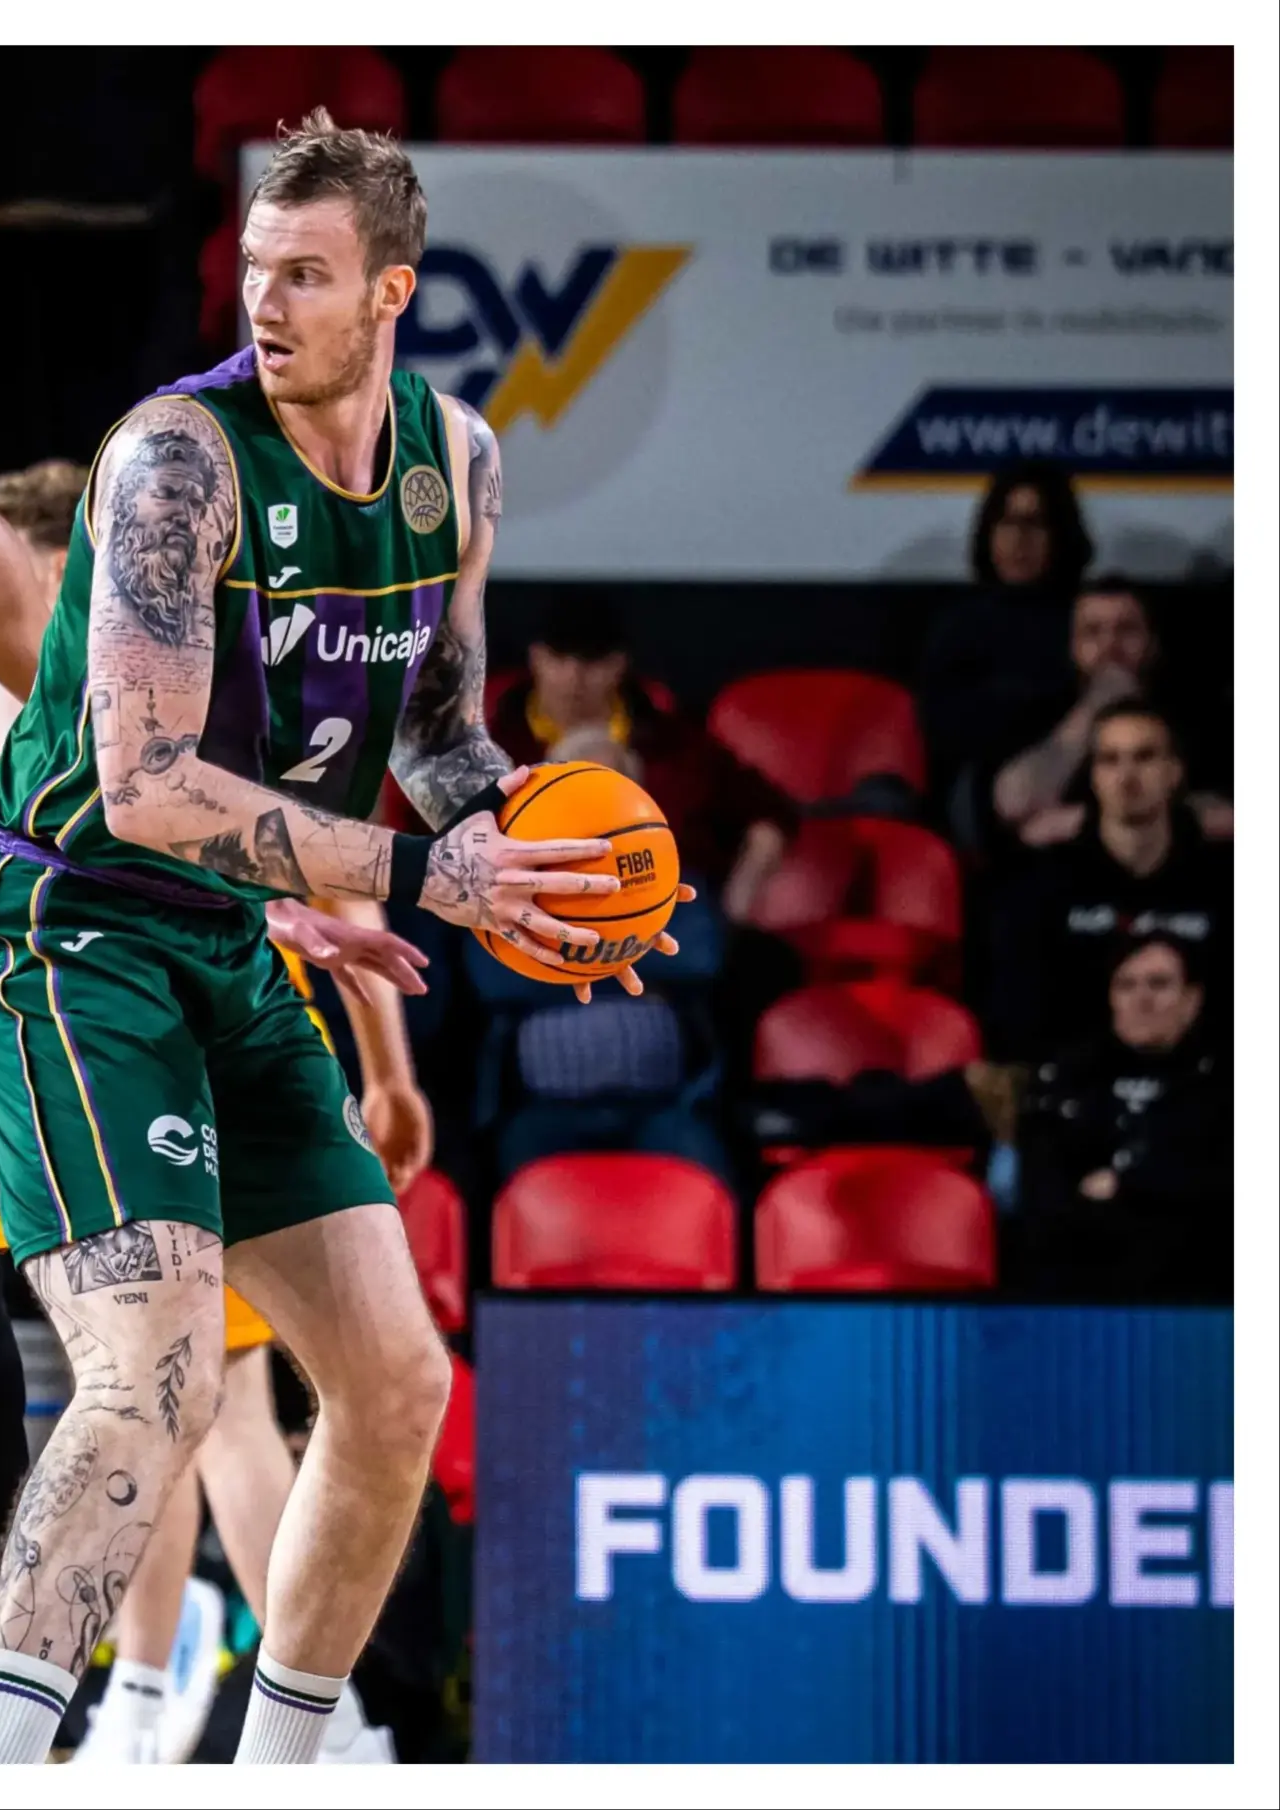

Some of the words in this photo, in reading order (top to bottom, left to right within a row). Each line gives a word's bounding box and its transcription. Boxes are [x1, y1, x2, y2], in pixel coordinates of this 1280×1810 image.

[768, 237, 842, 278] DE
[866, 237, 1039, 278] WITTE
[916, 404, 1234, 457] www.dewit
[317, 618, 431, 668] Unicaja
[279, 717, 352, 783] 2
[616, 848, 654, 878] FIBA
[201, 1124, 217, 1146] CO
[113, 1292, 149, 1305] VENI
